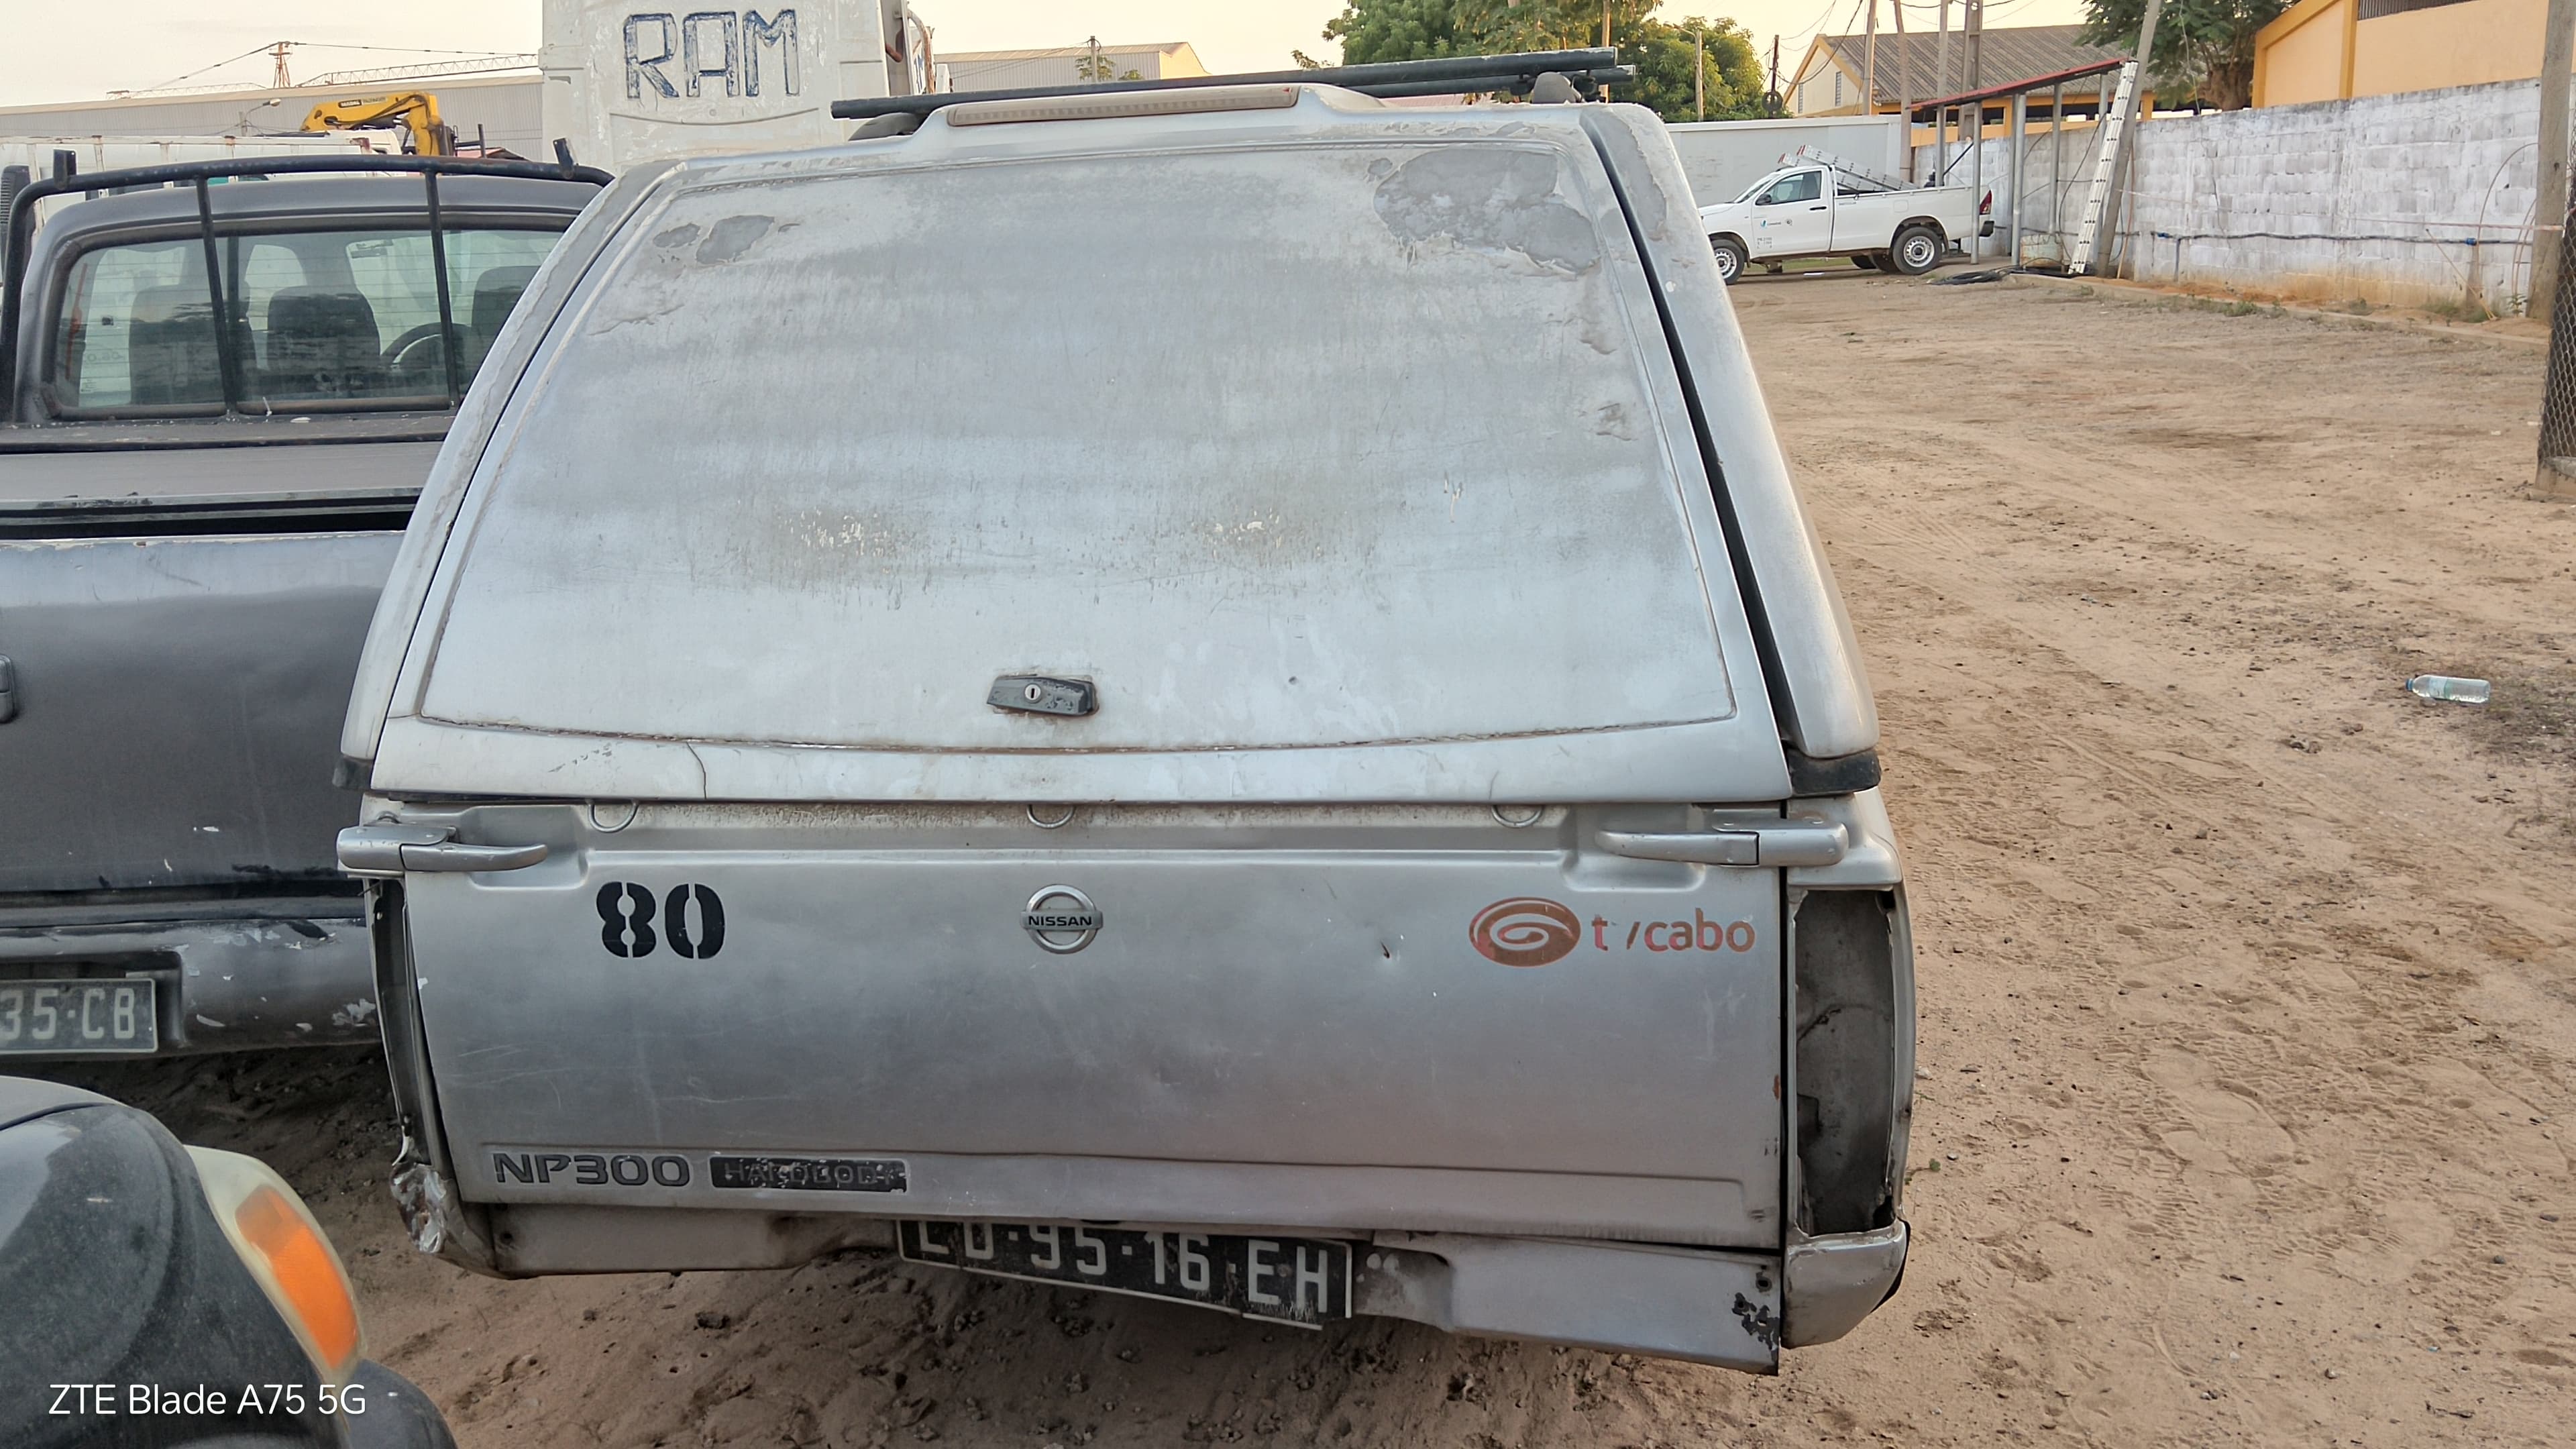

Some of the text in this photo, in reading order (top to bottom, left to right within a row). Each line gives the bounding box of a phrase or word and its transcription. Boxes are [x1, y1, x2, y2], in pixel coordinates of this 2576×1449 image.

[623, 9, 800, 99] RAM
[596, 881, 726, 959] 80
[1028, 915, 1093, 926] NISSAN
[492, 1152, 691, 1187] NP300
